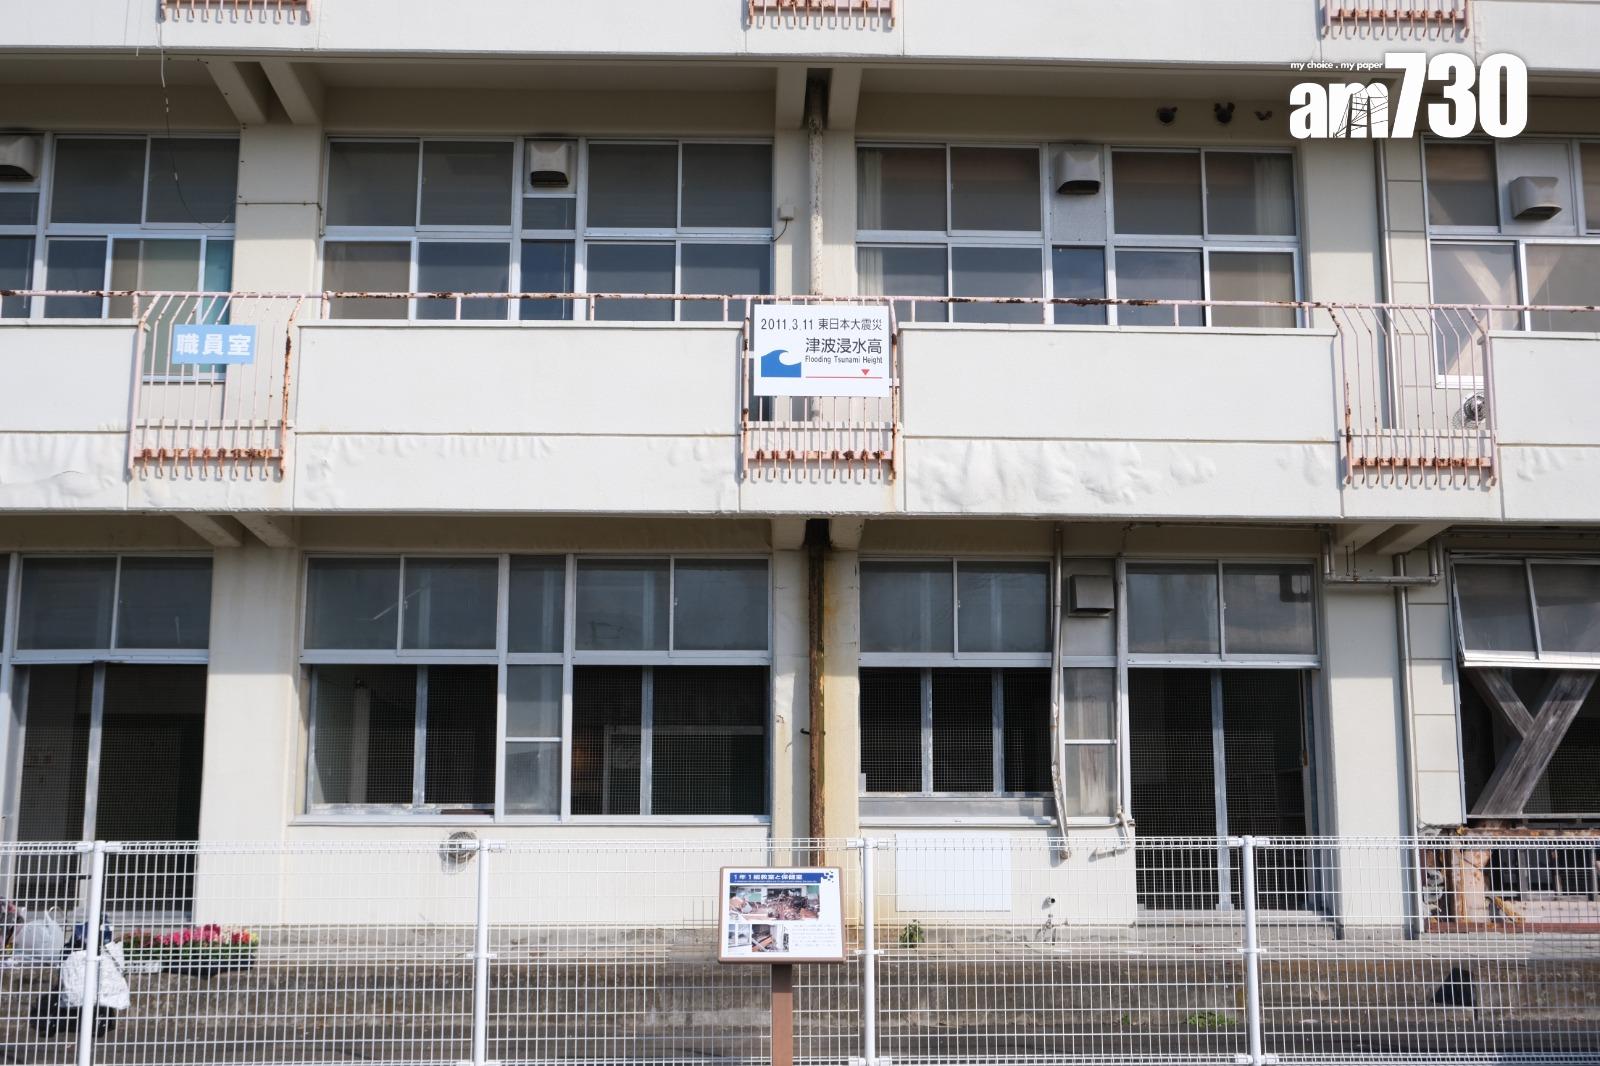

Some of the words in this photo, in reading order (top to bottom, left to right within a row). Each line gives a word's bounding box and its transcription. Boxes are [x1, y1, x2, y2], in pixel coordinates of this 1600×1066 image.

[761, 318, 813, 330] 2011.3.11
[818, 318, 882, 331] 東日本大震災
[176, 333, 251, 356] 職員室
[805, 337, 883, 354] 津波浸水高
[805, 355, 831, 364] Flooding
[834, 355, 860, 363] Tsunami
[862, 356, 883, 364] Height
